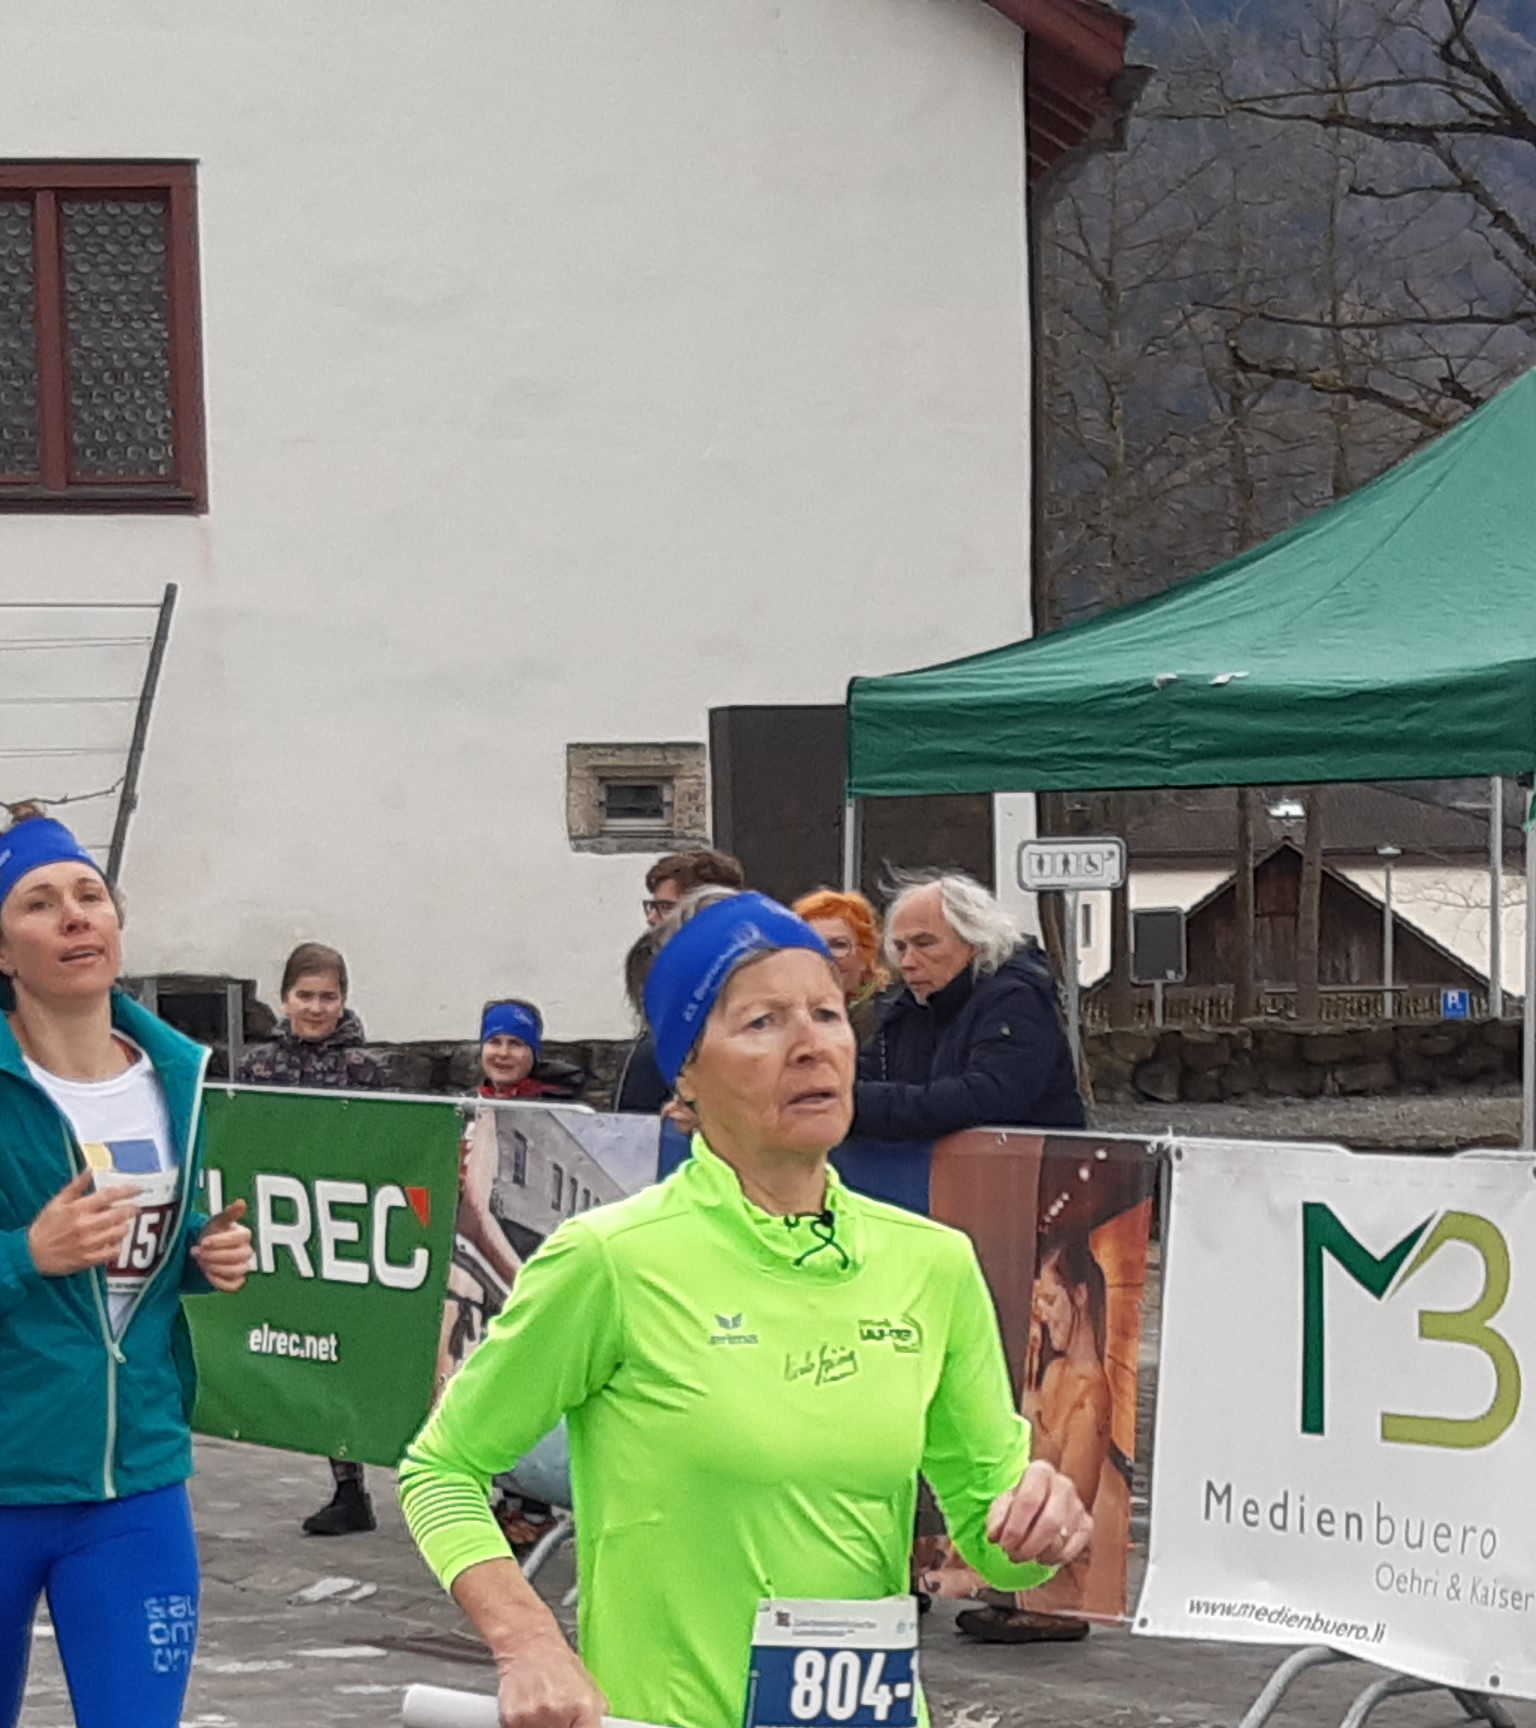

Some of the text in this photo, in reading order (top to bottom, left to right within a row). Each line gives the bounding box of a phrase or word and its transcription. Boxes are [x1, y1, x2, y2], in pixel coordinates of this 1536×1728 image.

[249, 1322, 339, 1362] elrec.net
[1203, 1479, 1498, 1561] Medienbuero
[1374, 1561, 1439, 1598] Oehri
[1446, 1572, 1462, 1602] &
[1469, 1575, 1536, 1613] Kaiser
[1187, 1597, 1386, 1644] www.medienbuero.li
